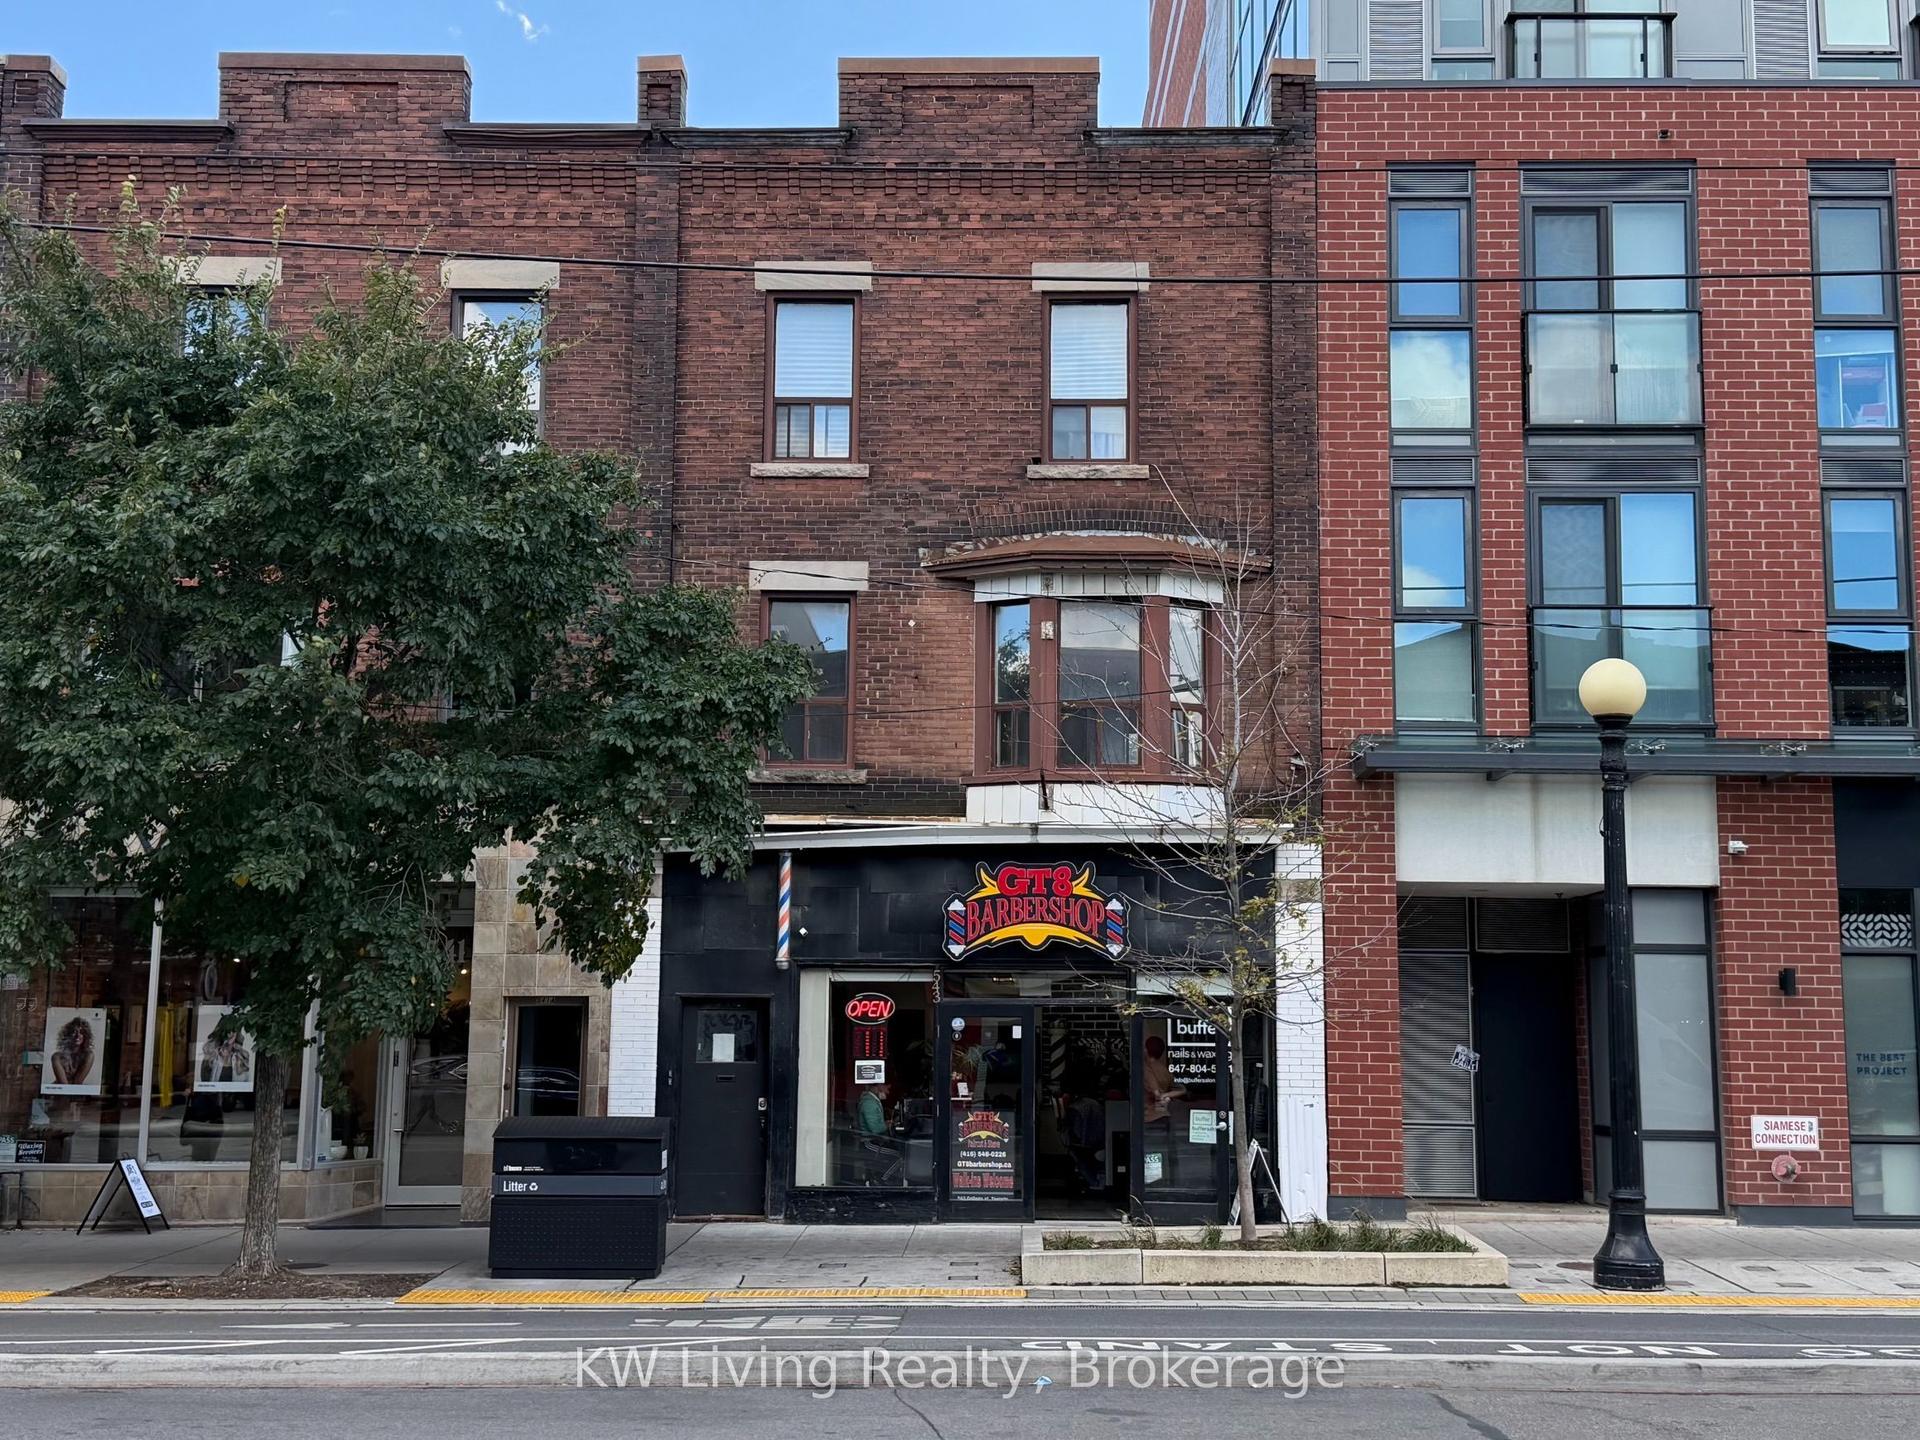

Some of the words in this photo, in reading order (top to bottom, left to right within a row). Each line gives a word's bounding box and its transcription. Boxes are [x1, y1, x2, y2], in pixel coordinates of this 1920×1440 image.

[997, 866, 1073, 897] GT8
[966, 897, 1105, 942] BARBERSHOP
[931, 969, 941, 1004] 543
[847, 1000, 891, 1017] OPEN
[1176, 1019, 1216, 1034] buffe
[1168, 1048, 1190, 1058] nails
[1856, 1053, 1876, 1062] THE
[1856, 1066, 1907, 1076] PROJECT
[974, 1111, 994, 1121] GT8
[1764, 1120, 1806, 1131] SIAMESE
[1755, 1133, 1816, 1145] CONNECTION
[1145, 1154, 1159, 1163] ASS
[503, 1180, 528, 1192] Litter
